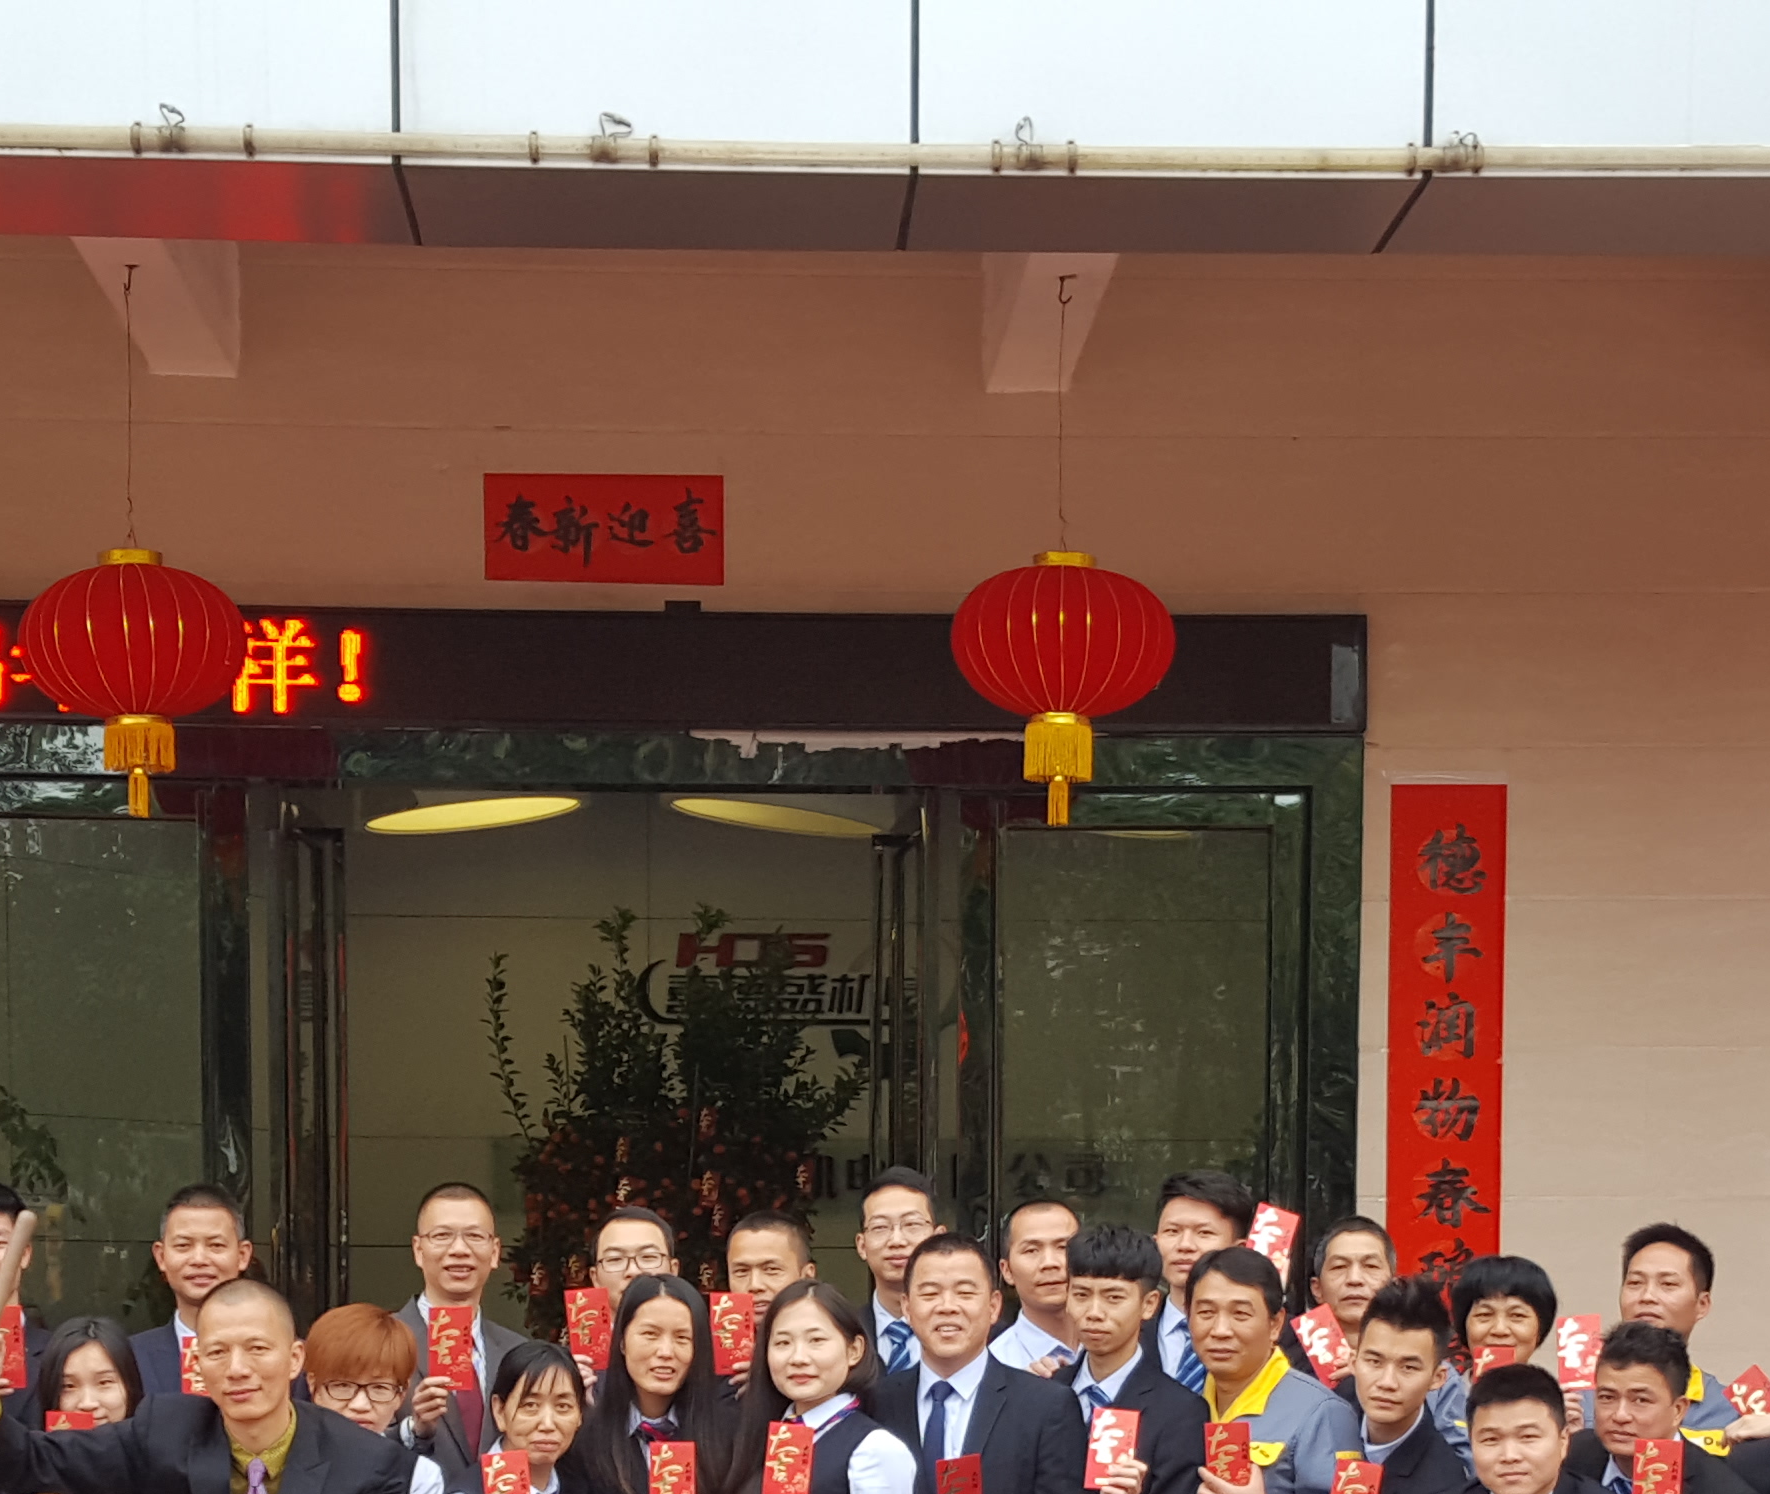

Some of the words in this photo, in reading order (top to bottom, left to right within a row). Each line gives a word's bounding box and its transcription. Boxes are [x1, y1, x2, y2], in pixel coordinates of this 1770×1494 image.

[430, 1309, 461, 1365] 大吉
[712, 1294, 744, 1349] 大吉
[766, 1425, 800, 1483] 大吉
